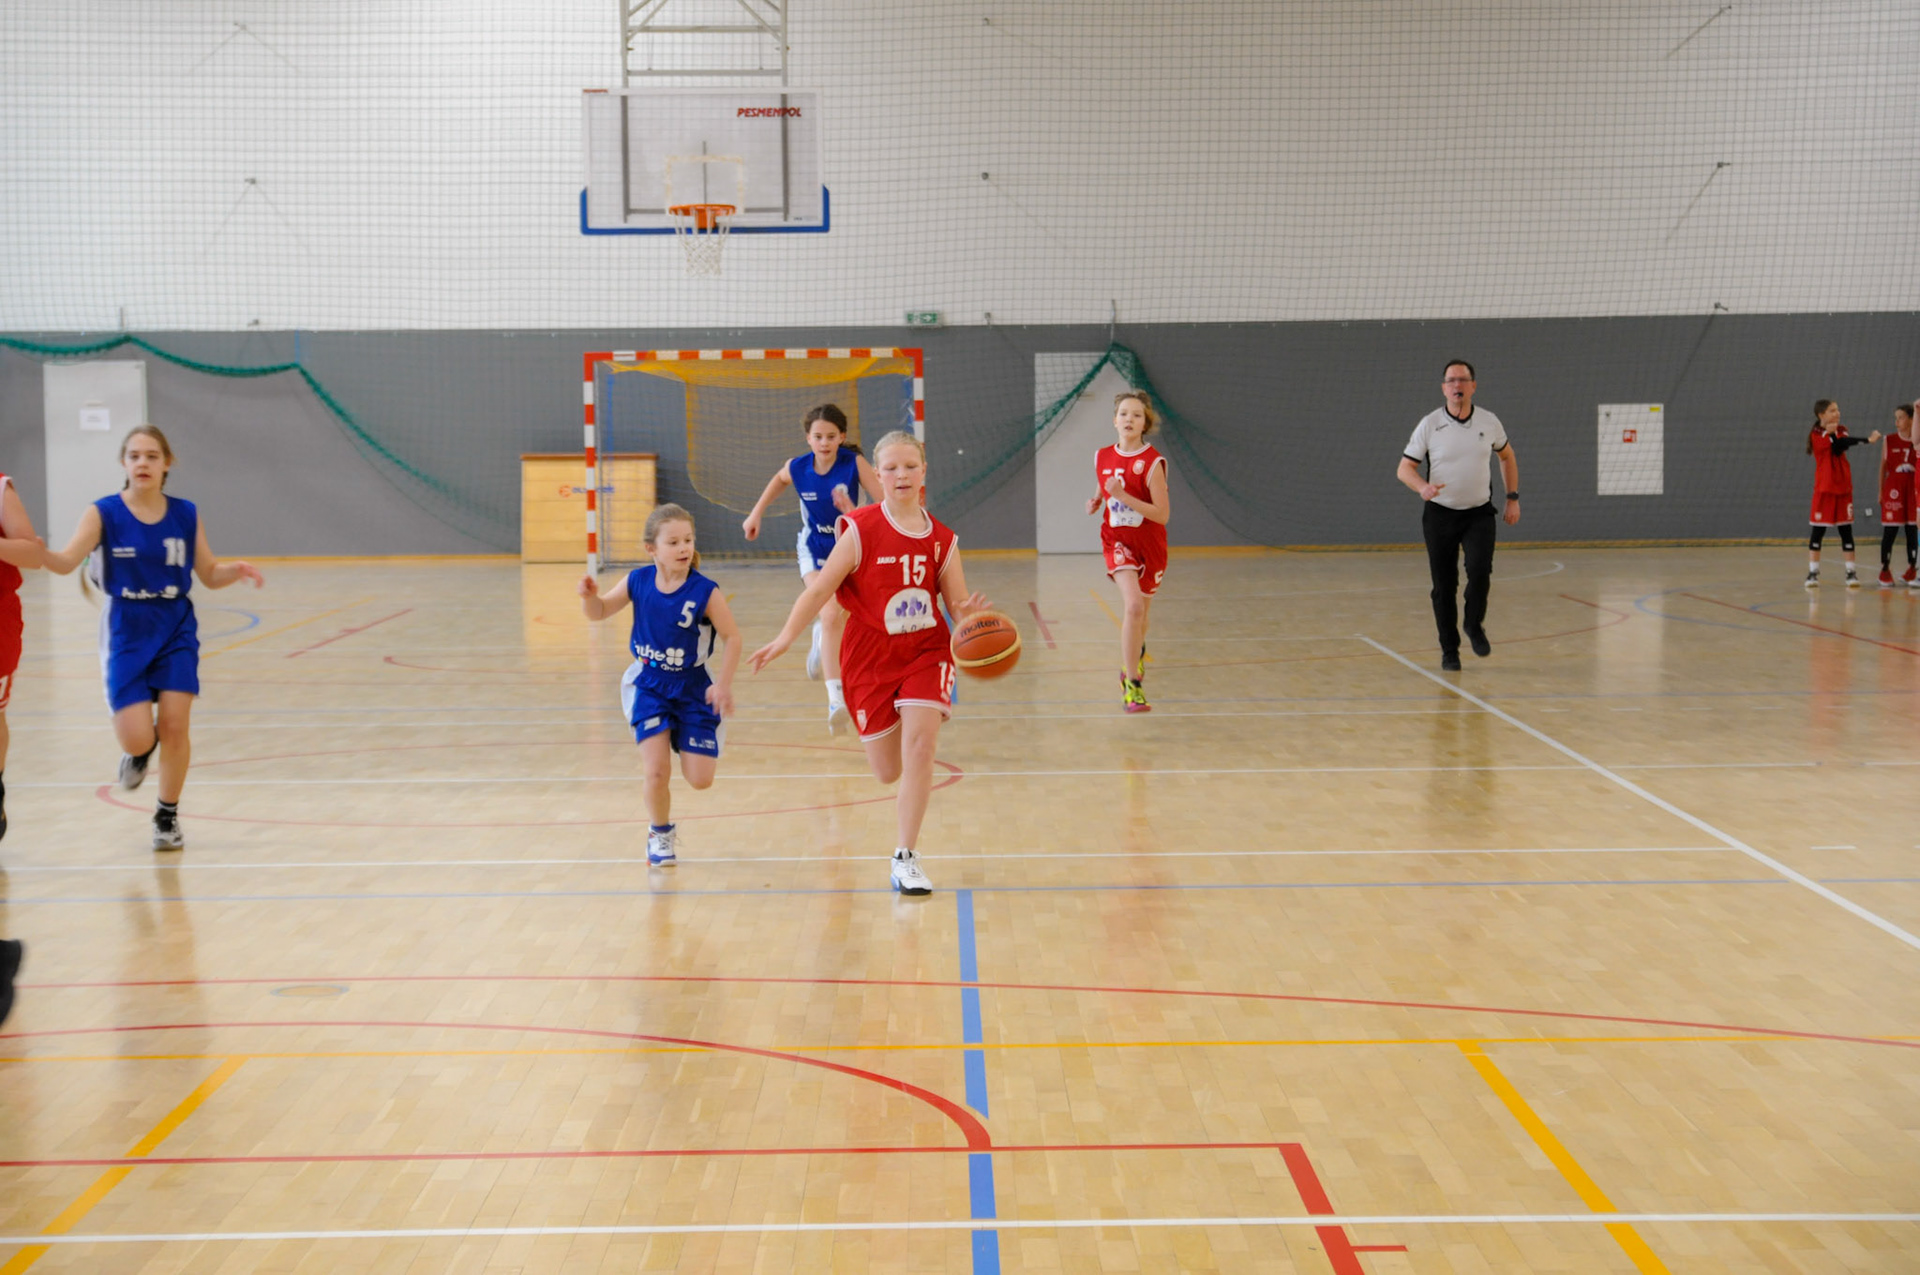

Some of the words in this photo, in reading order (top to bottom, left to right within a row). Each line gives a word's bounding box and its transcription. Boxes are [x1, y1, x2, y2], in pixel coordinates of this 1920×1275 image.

[737, 107, 802, 117] PESMENPOL
[1903, 448, 1910, 462] 7
[899, 554, 927, 586] 15
[677, 600, 697, 628] 5
[960, 619, 1000, 638] molten
